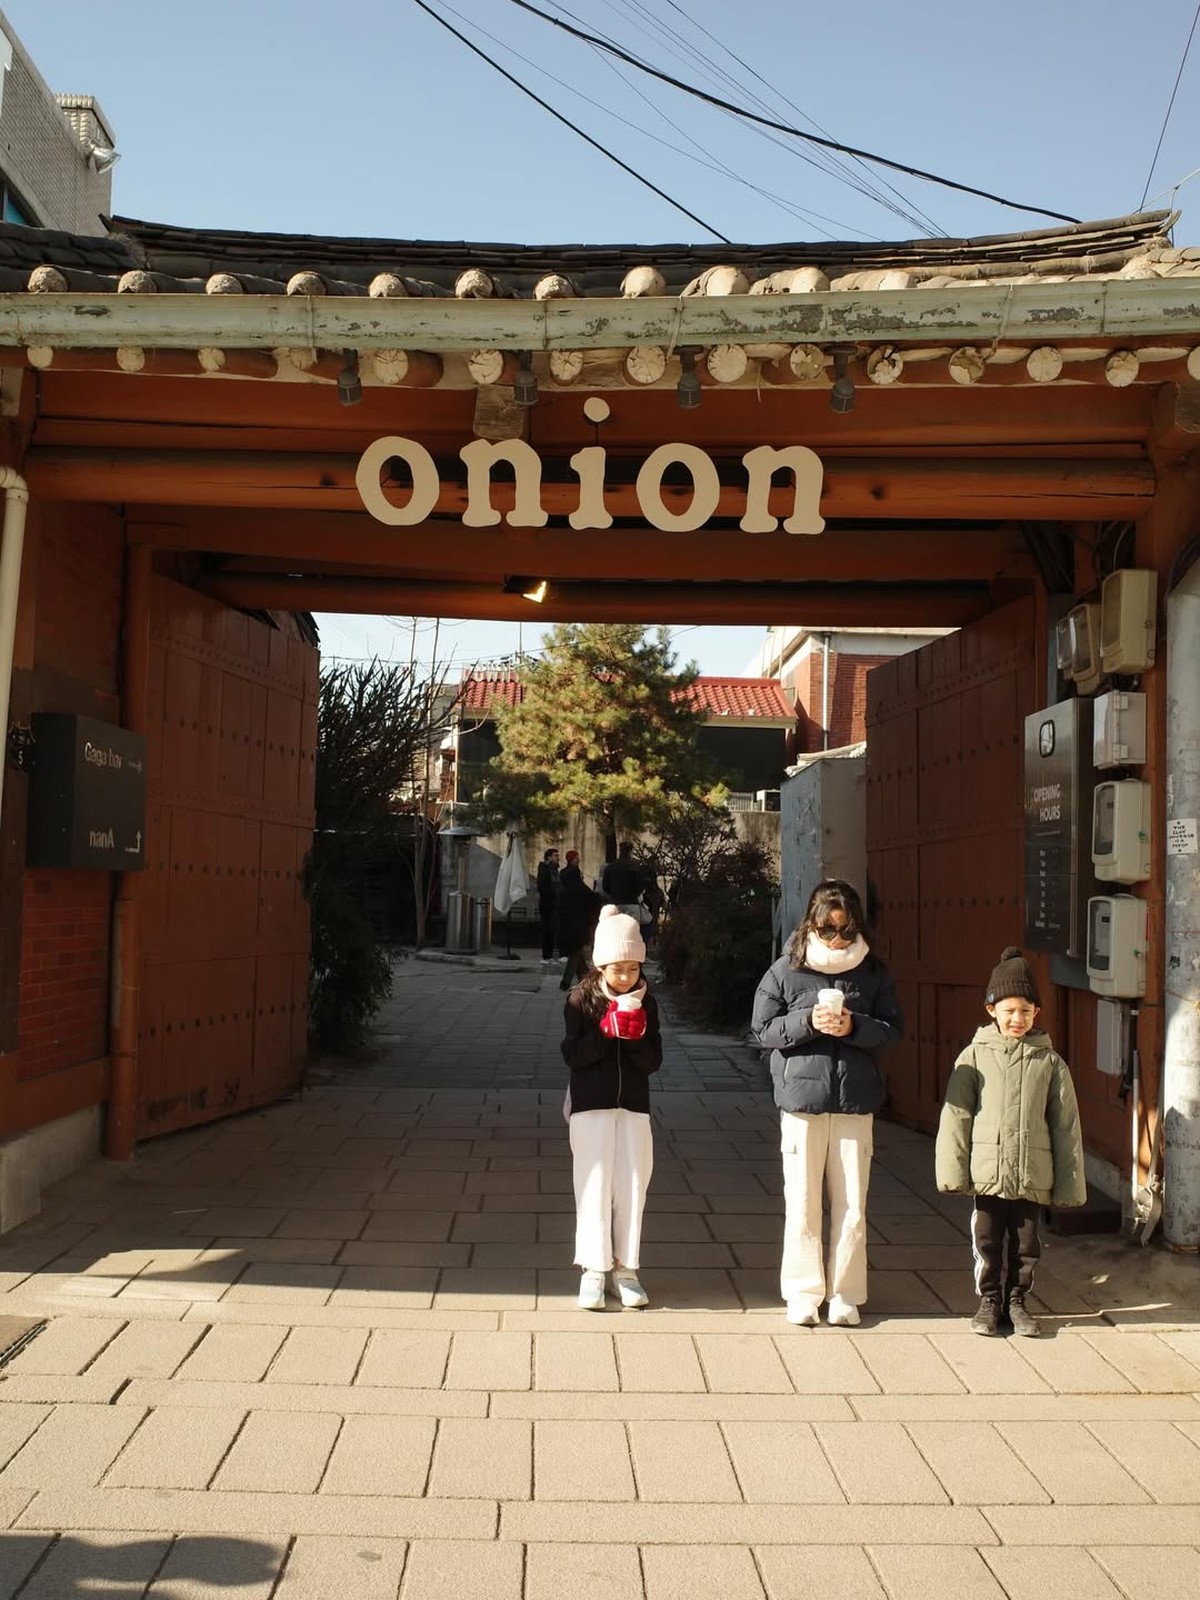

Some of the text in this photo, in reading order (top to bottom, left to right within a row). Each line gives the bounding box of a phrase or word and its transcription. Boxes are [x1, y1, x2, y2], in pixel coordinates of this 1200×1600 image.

[355, 397, 825, 534] onion
[85, 742, 122, 768] Gaga bar
[1033, 783, 1061, 803] OPENING
[1039, 804, 1061, 823] HOURS
[89, 828, 114, 848] nanA
